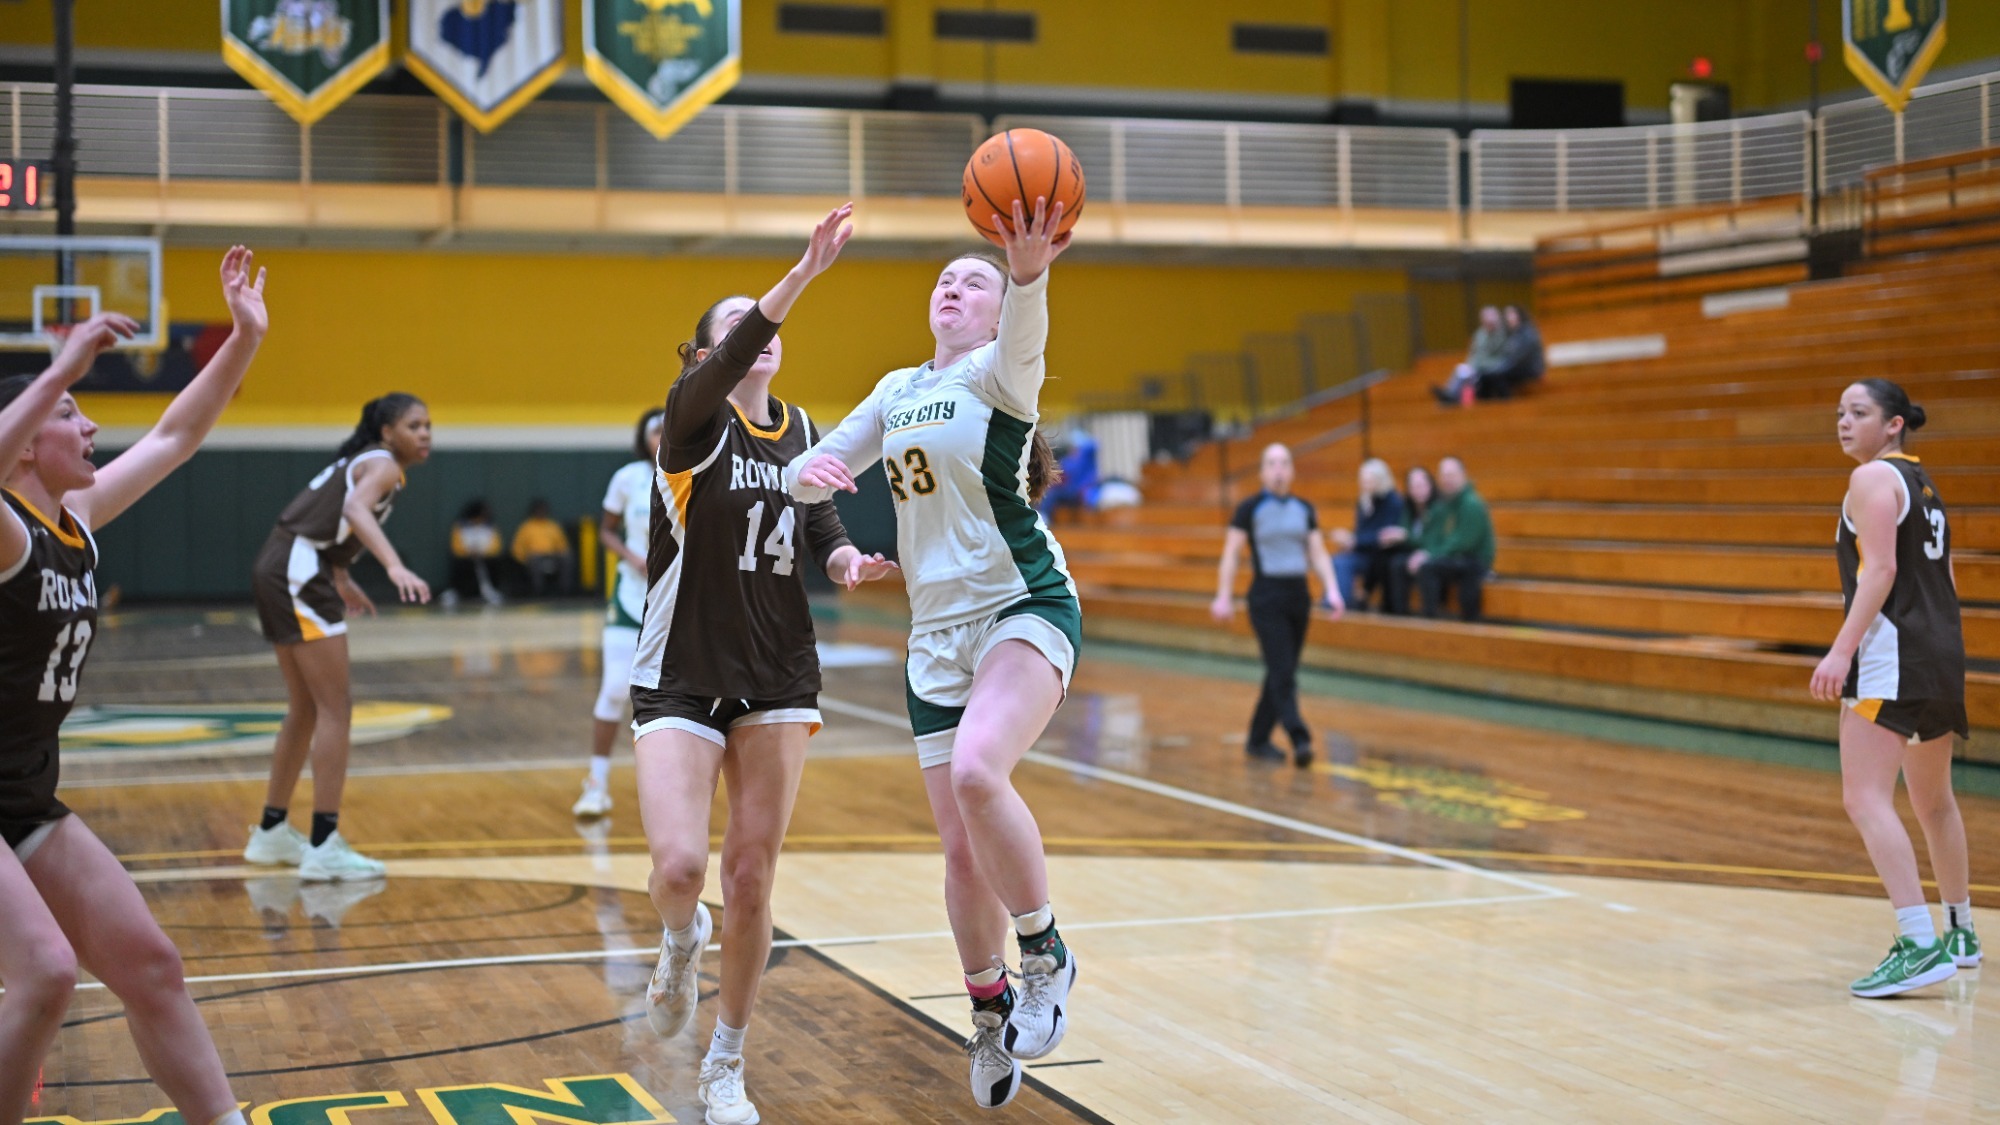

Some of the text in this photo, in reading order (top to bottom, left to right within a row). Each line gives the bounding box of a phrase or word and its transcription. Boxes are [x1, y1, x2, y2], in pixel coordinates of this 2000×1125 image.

[916, 400, 956, 423] CITY
[729, 453, 788, 495] ROW
[886, 446, 938, 502] 23
[738, 500, 796, 577] 14
[37, 619, 92, 702] 13
